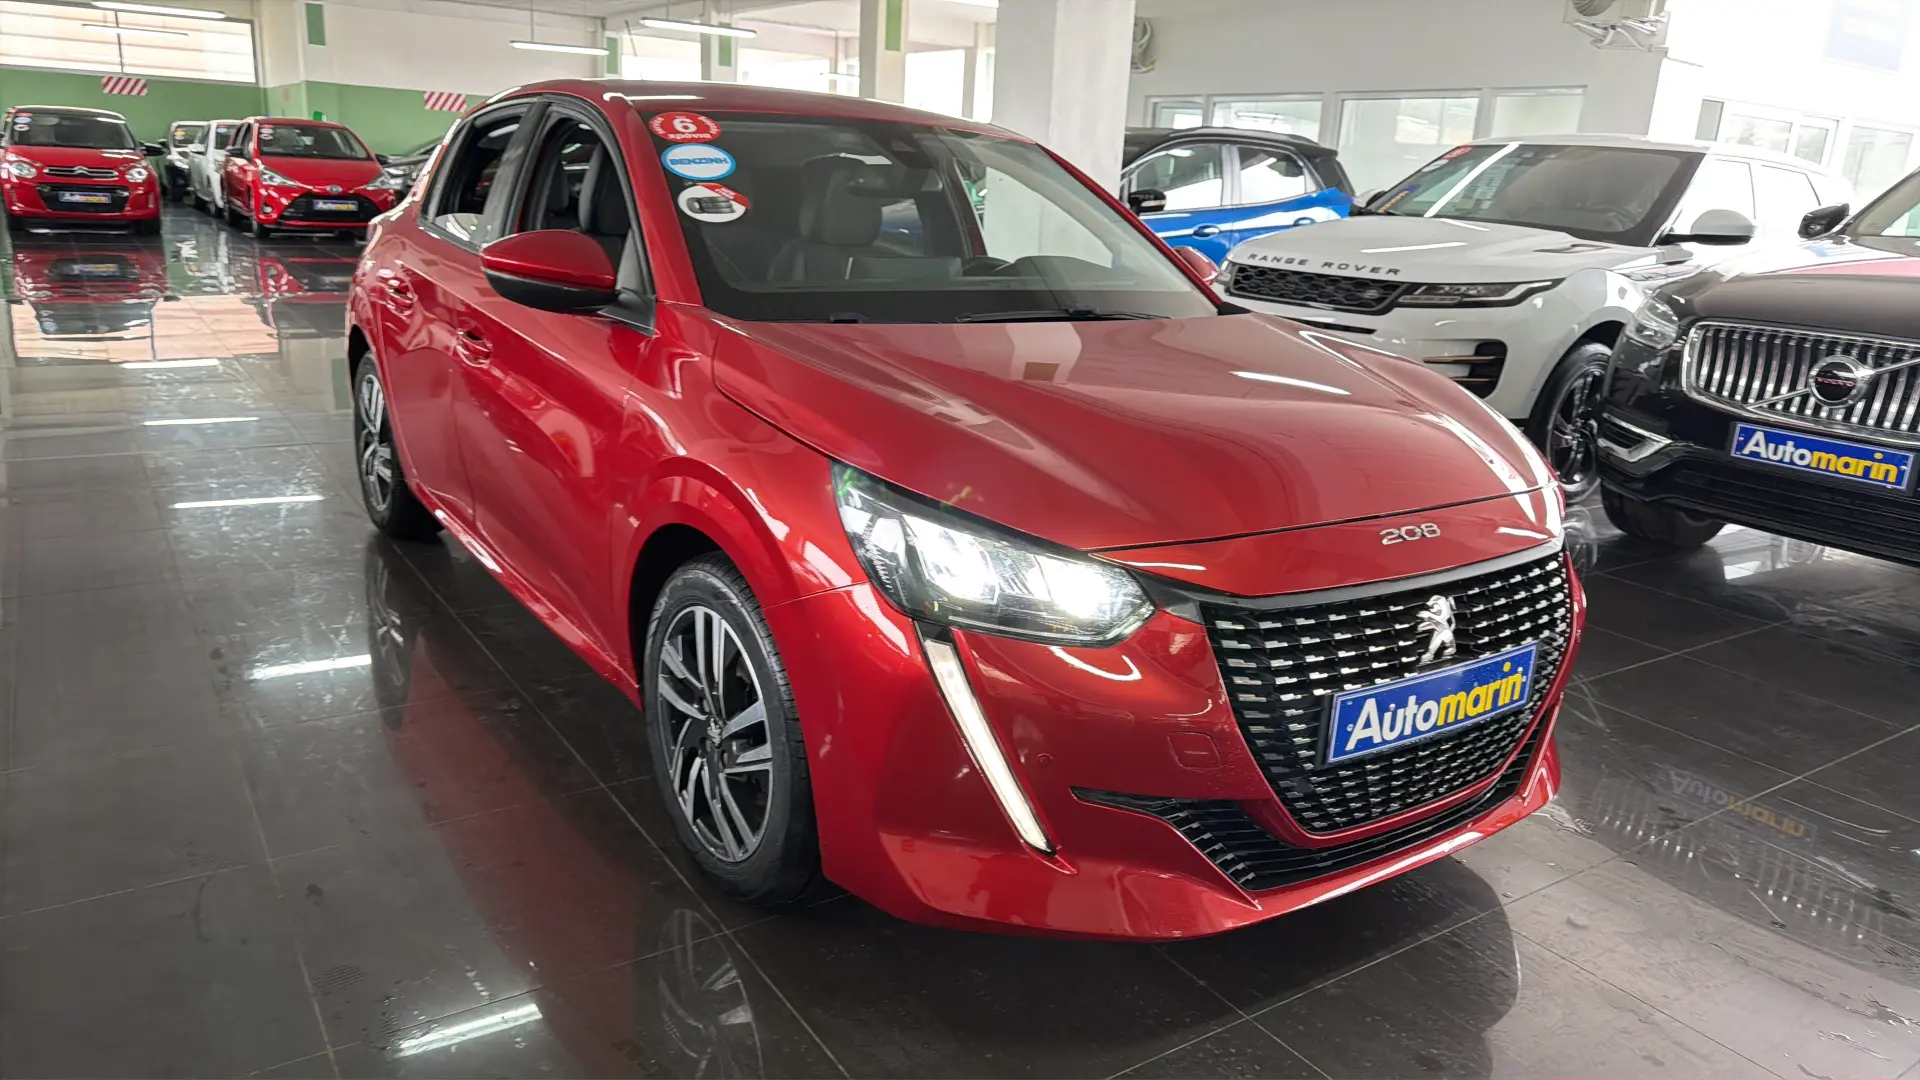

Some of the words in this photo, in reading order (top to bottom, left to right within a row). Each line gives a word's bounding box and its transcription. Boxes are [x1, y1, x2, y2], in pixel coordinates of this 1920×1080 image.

[672, 117, 697, 133] 6
[1247, 253, 1310, 266] RANGE
[1321, 261, 1401, 276] ROVER
[1742, 431, 1899, 483] Automarin
[1379, 523, 1441, 545] 208
[1345, 662, 1523, 750] Automarin
